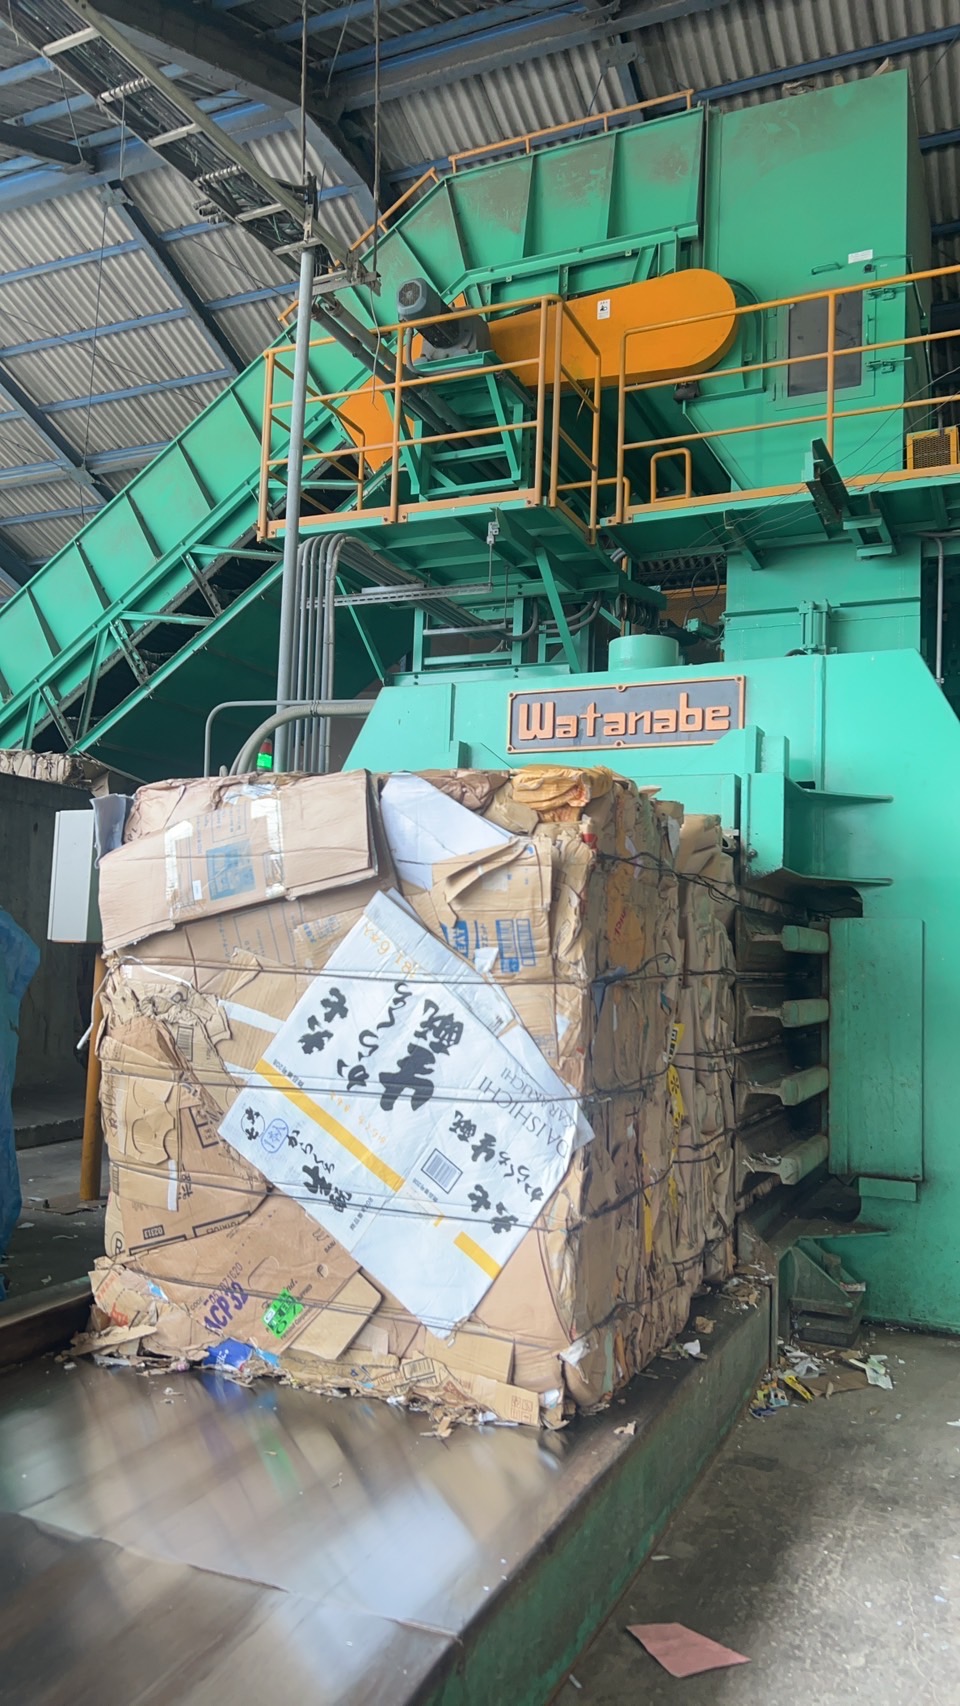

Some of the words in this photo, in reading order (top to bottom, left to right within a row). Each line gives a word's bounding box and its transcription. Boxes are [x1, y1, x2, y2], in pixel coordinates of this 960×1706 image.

[518, 692, 731, 740] Watanabe
[297, 987, 349, 1055] 大七
[337, 982, 413, 1091] からくち
[479, 1076, 567, 1158] DAISHICHI
[501, 1067, 576, 1127] KARAKUCHI
[287, 1129, 335, 1174] からくち
[467, 1184, 519, 1234] 大七
